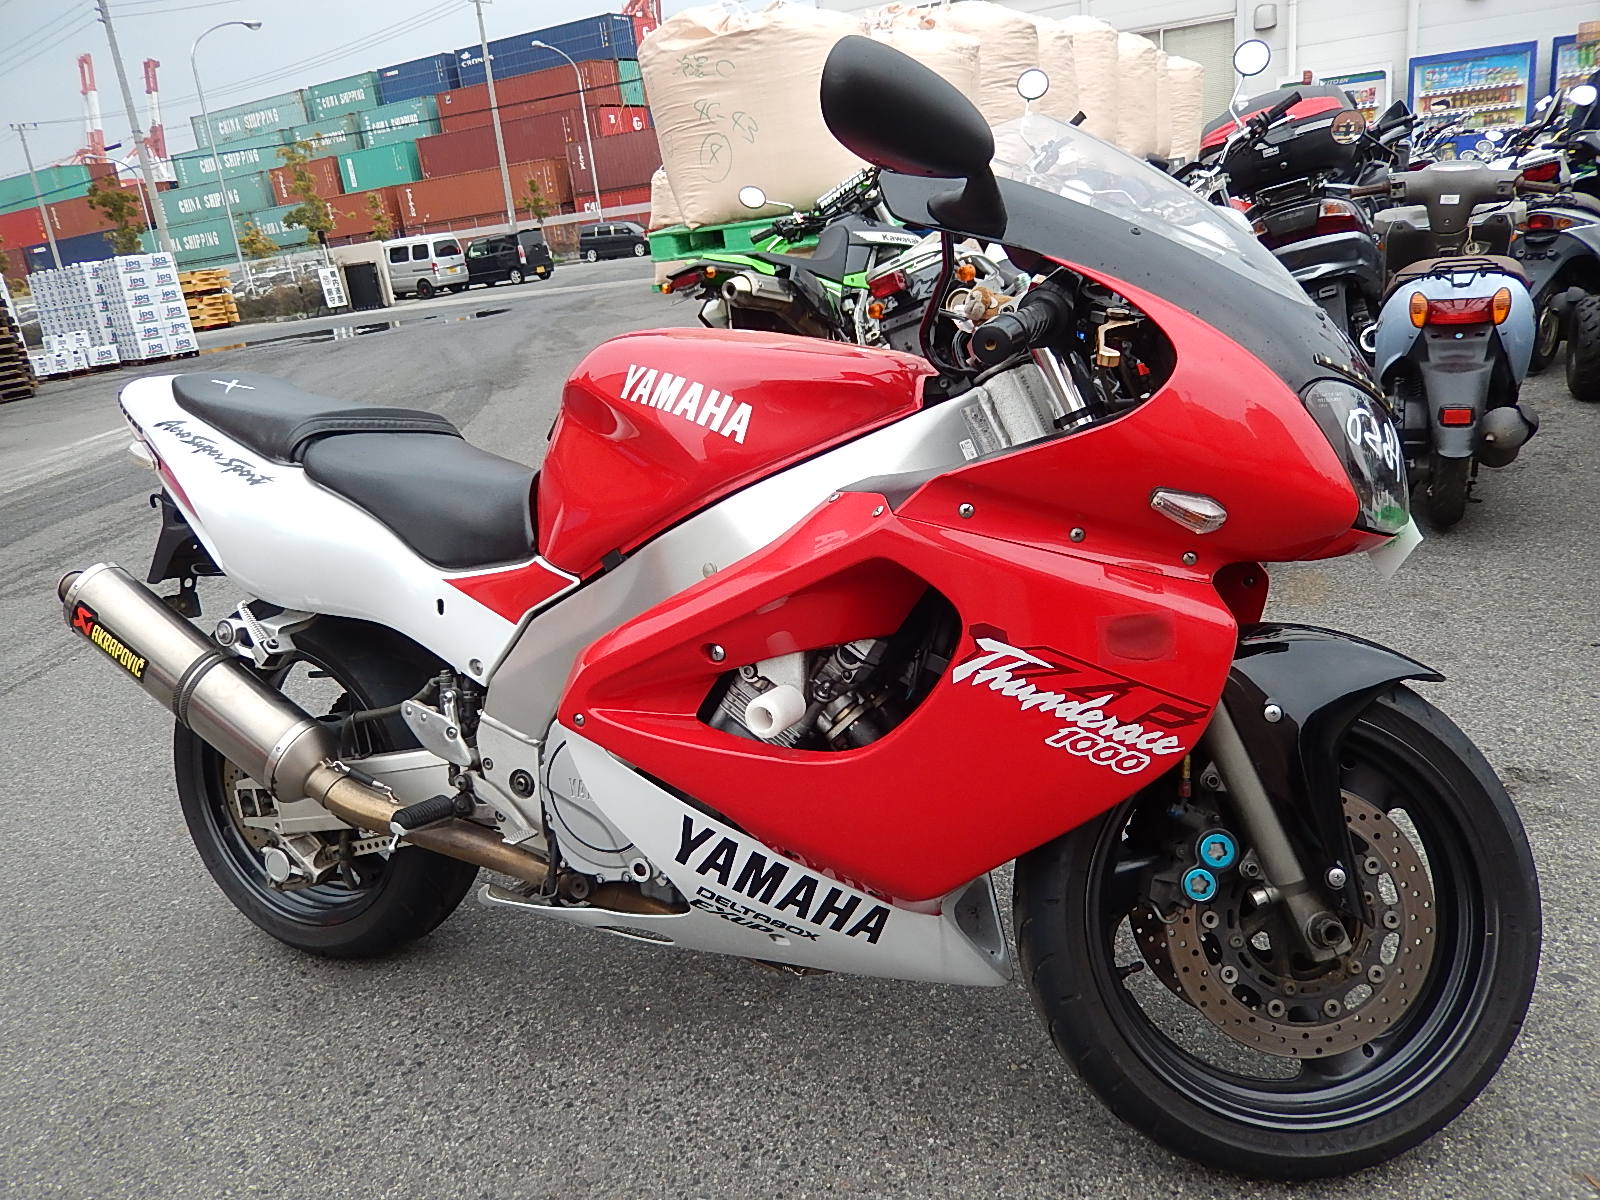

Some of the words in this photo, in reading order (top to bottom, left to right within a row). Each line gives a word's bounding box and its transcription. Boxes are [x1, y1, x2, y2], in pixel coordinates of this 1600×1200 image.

[340, 88, 366, 105] SHIPPING
[218, 117, 241, 135] CHINA
[243, 108, 279, 130] SHIPPING
[223, 148, 260, 168] SHIPPING
[178, 196, 202, 214] CHINA
[203, 188, 240, 209] SHIPNG
[183, 231, 220, 251] SHIPPING
[620, 364, 753, 445] YAMAHA
[179, 435, 228, 461] Super
[215, 458, 278, 486] Sport
[953, 637, 1186, 755] Thunderace
[1045, 727, 1151, 775] 1000
[674, 814, 891, 945] YAMAHA
[695, 886, 821, 942] DELTABOX
